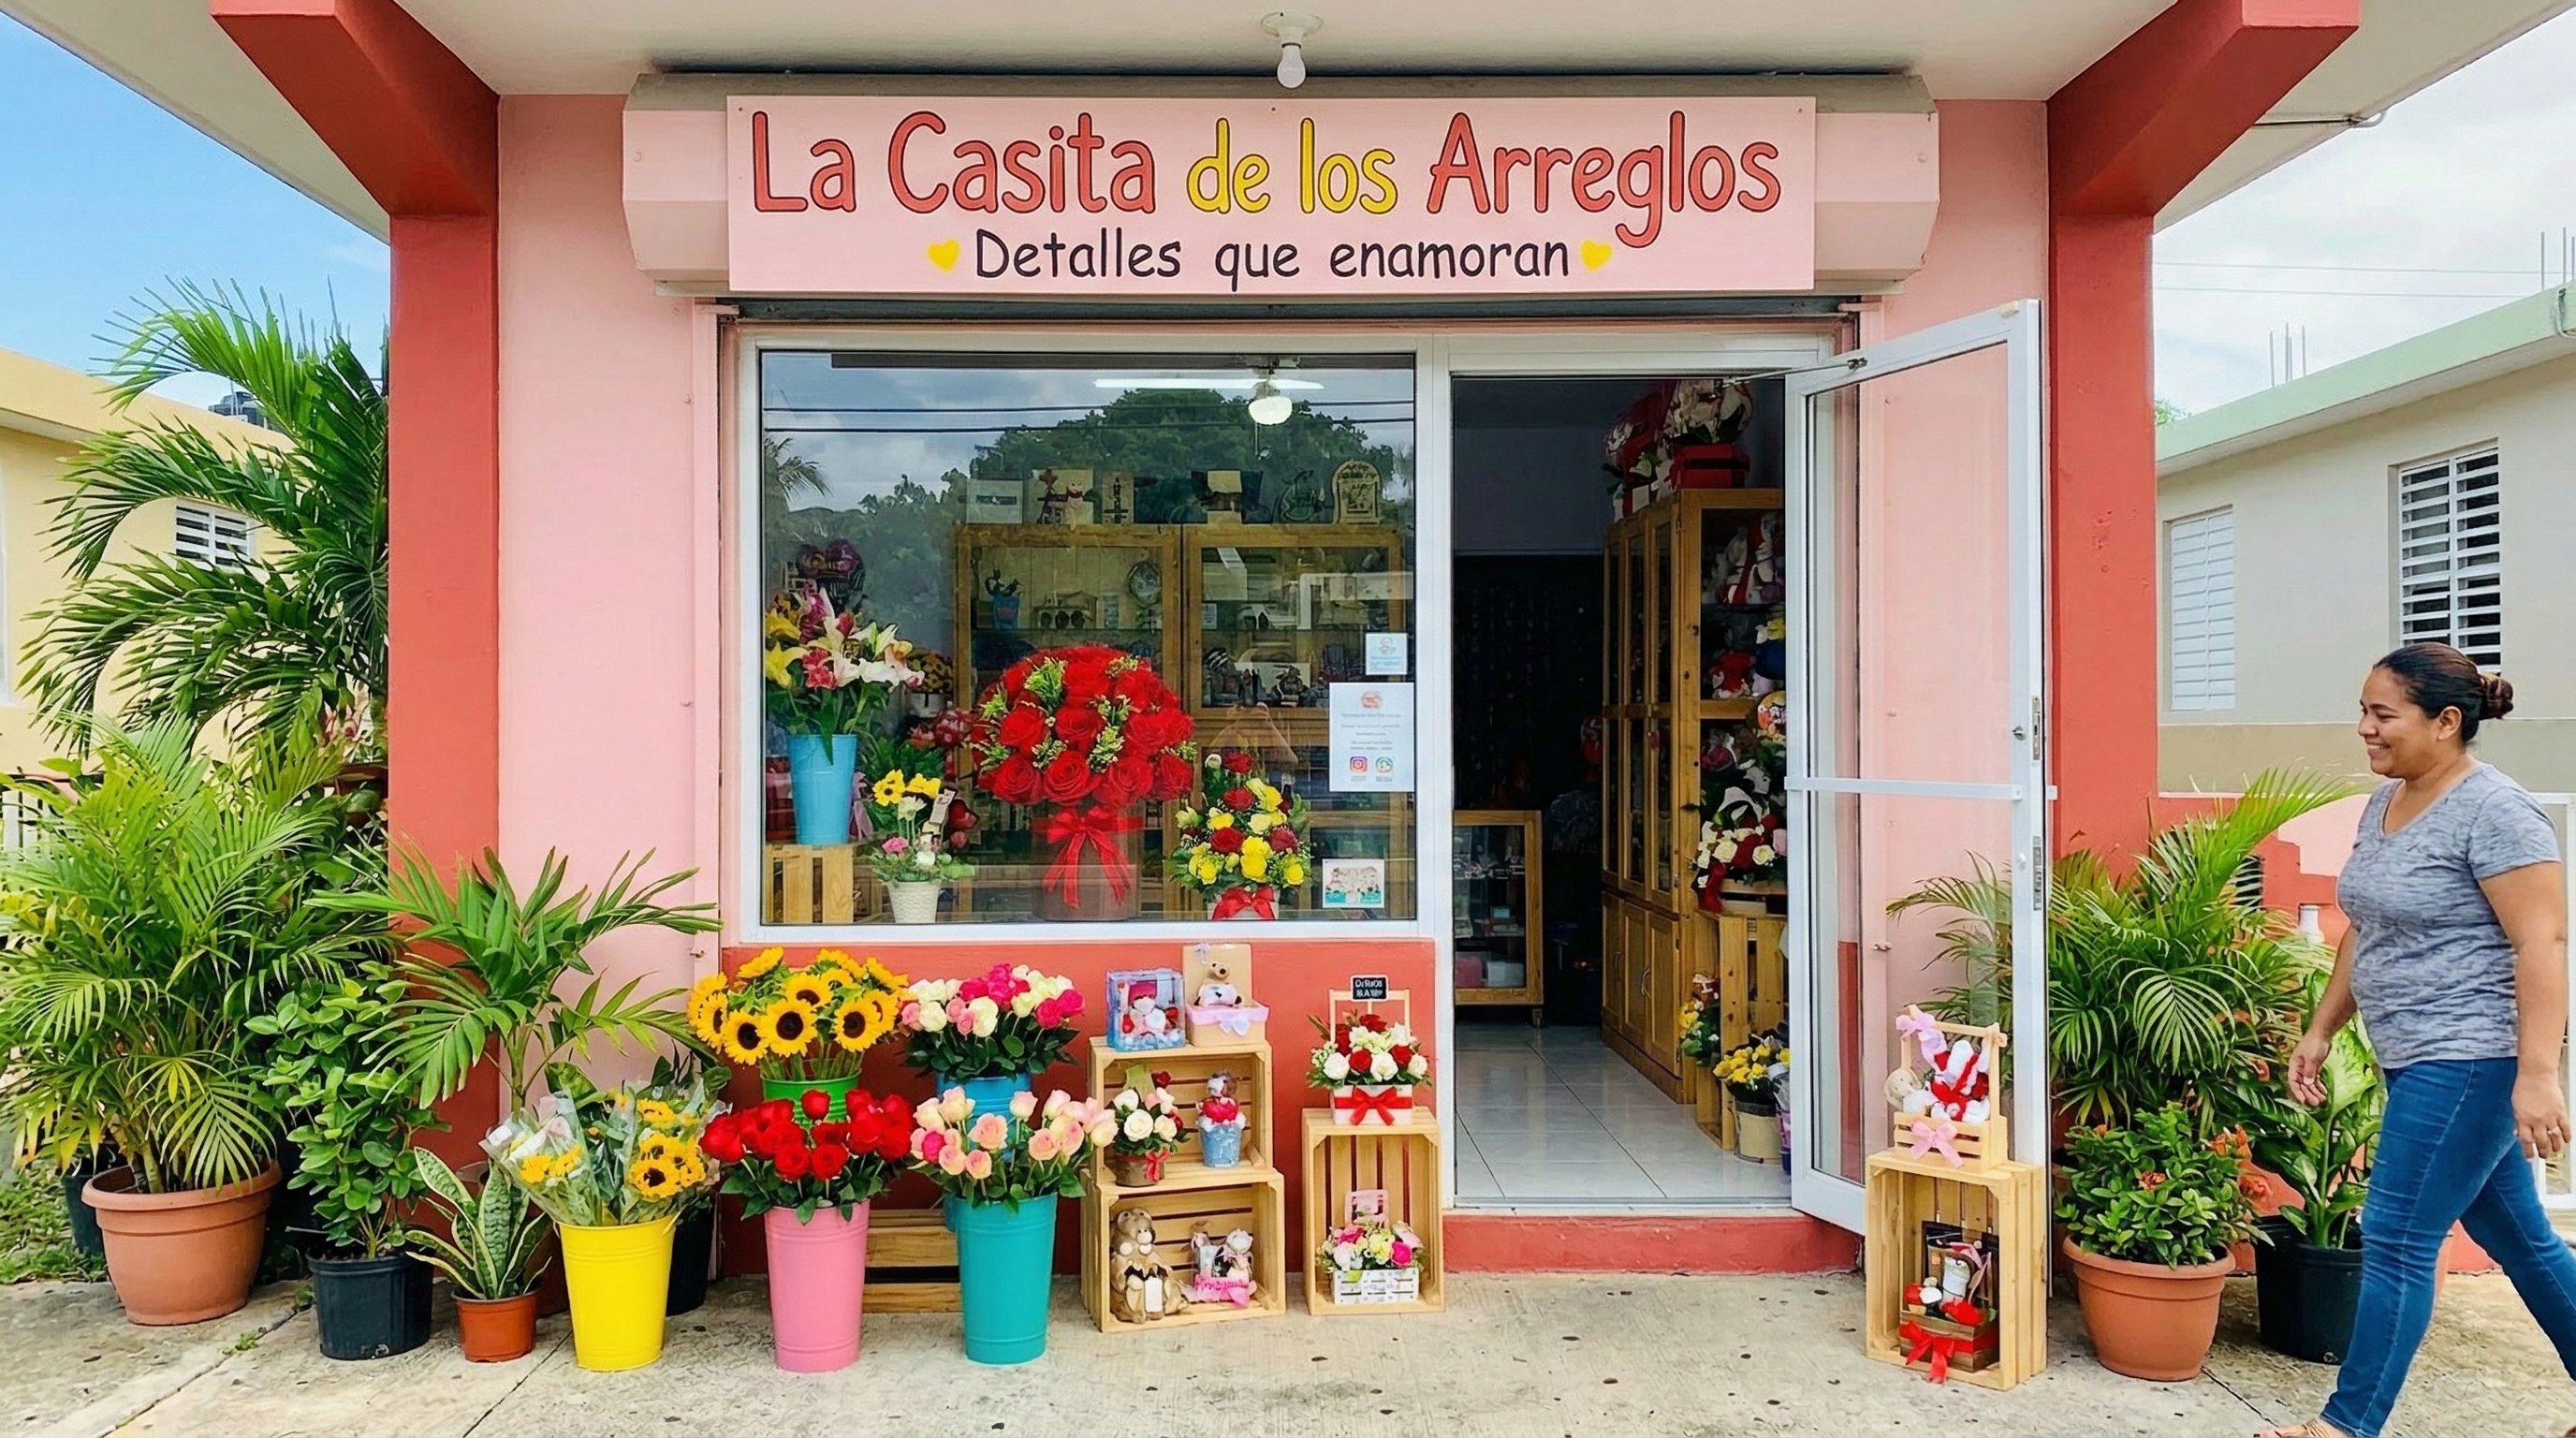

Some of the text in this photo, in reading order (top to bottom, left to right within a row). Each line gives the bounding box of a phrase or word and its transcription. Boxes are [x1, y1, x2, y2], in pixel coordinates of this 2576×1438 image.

[752, 110, 1782, 249] La Casita de los Arreglos
[975, 227, 1570, 292] Detalles que enamoran
